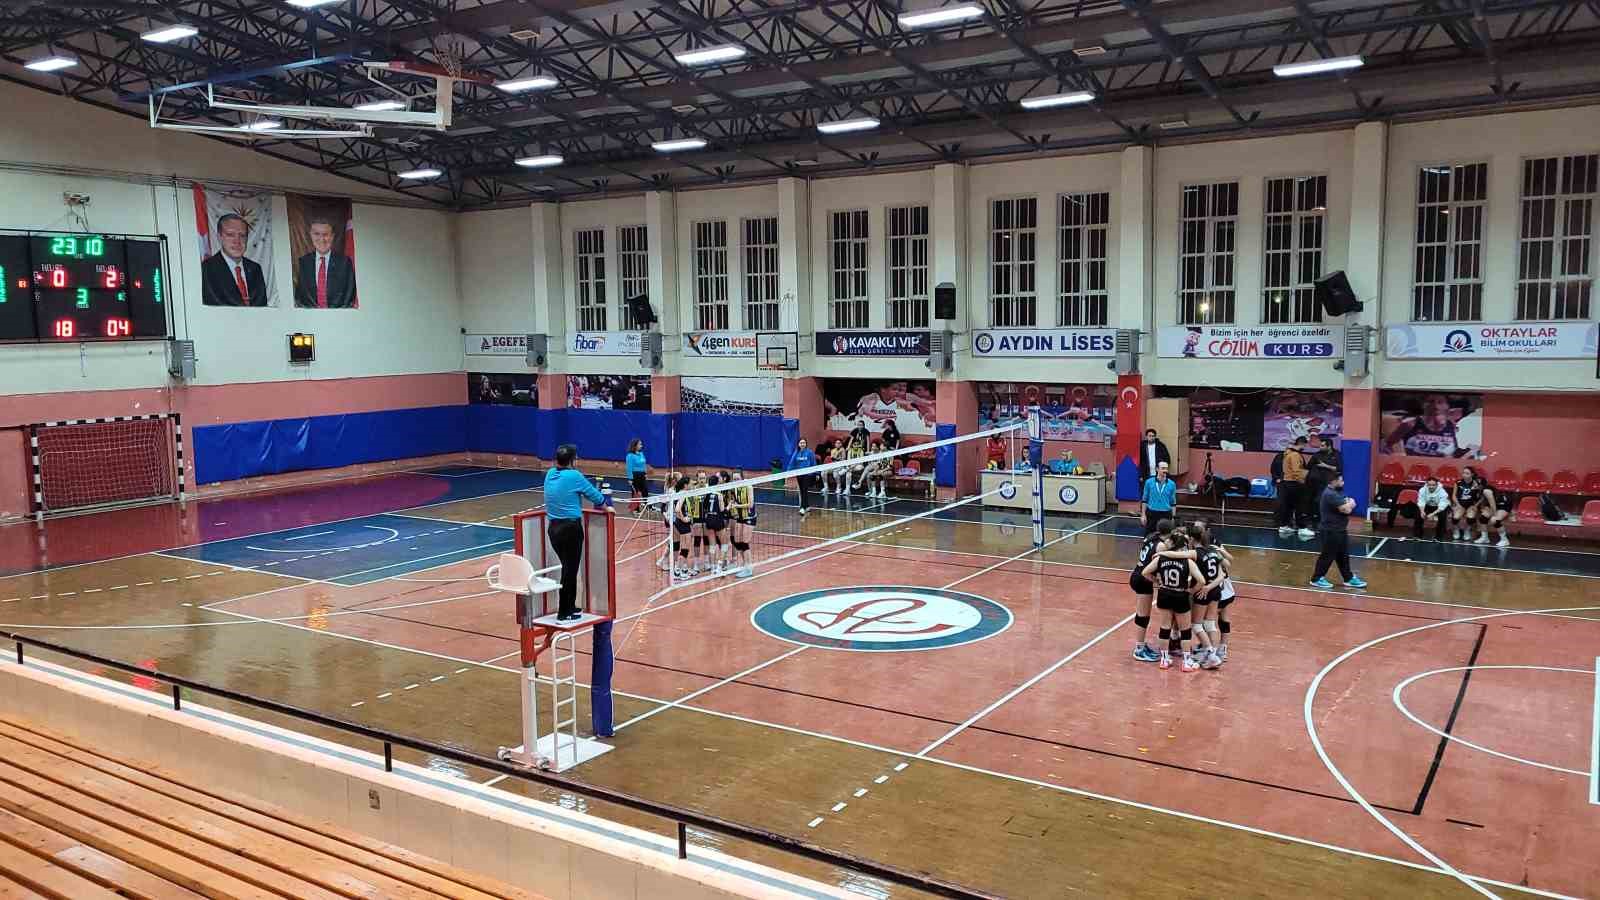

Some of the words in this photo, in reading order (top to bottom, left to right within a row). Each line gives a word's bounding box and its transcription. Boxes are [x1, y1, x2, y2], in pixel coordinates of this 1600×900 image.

[53, 270, 65, 287] 0
[106, 271, 117, 287] 2
[77, 288, 88, 304] 3
[56, 320, 73, 337] 18
[107, 320, 129, 337] 04
[1210, 328, 1232, 337] Bizim
[1233, 329, 1249, 339] için
[1250, 329, 1264, 337] her
[1268, 328, 1299, 338] öğrenci
[1301, 328, 1330, 337] özeldir
[1481, 327, 1557, 338] OKTAYLAR
[493, 336, 528, 346] EGEFE
[849, 336, 896, 348] KAVAKLI
[899, 335, 921, 348] VIP
[999, 335, 1053, 351] AYDIN
[1060, 333, 1114, 351] LİSES
[1481, 338, 1506, 347] BİLİM
[1507, 339, 1557, 347] OKULLARI
[1273, 344, 1324, 355] KURS
[1207, 558, 1216, 577] 5
[1164, 568, 1180, 587] 19
